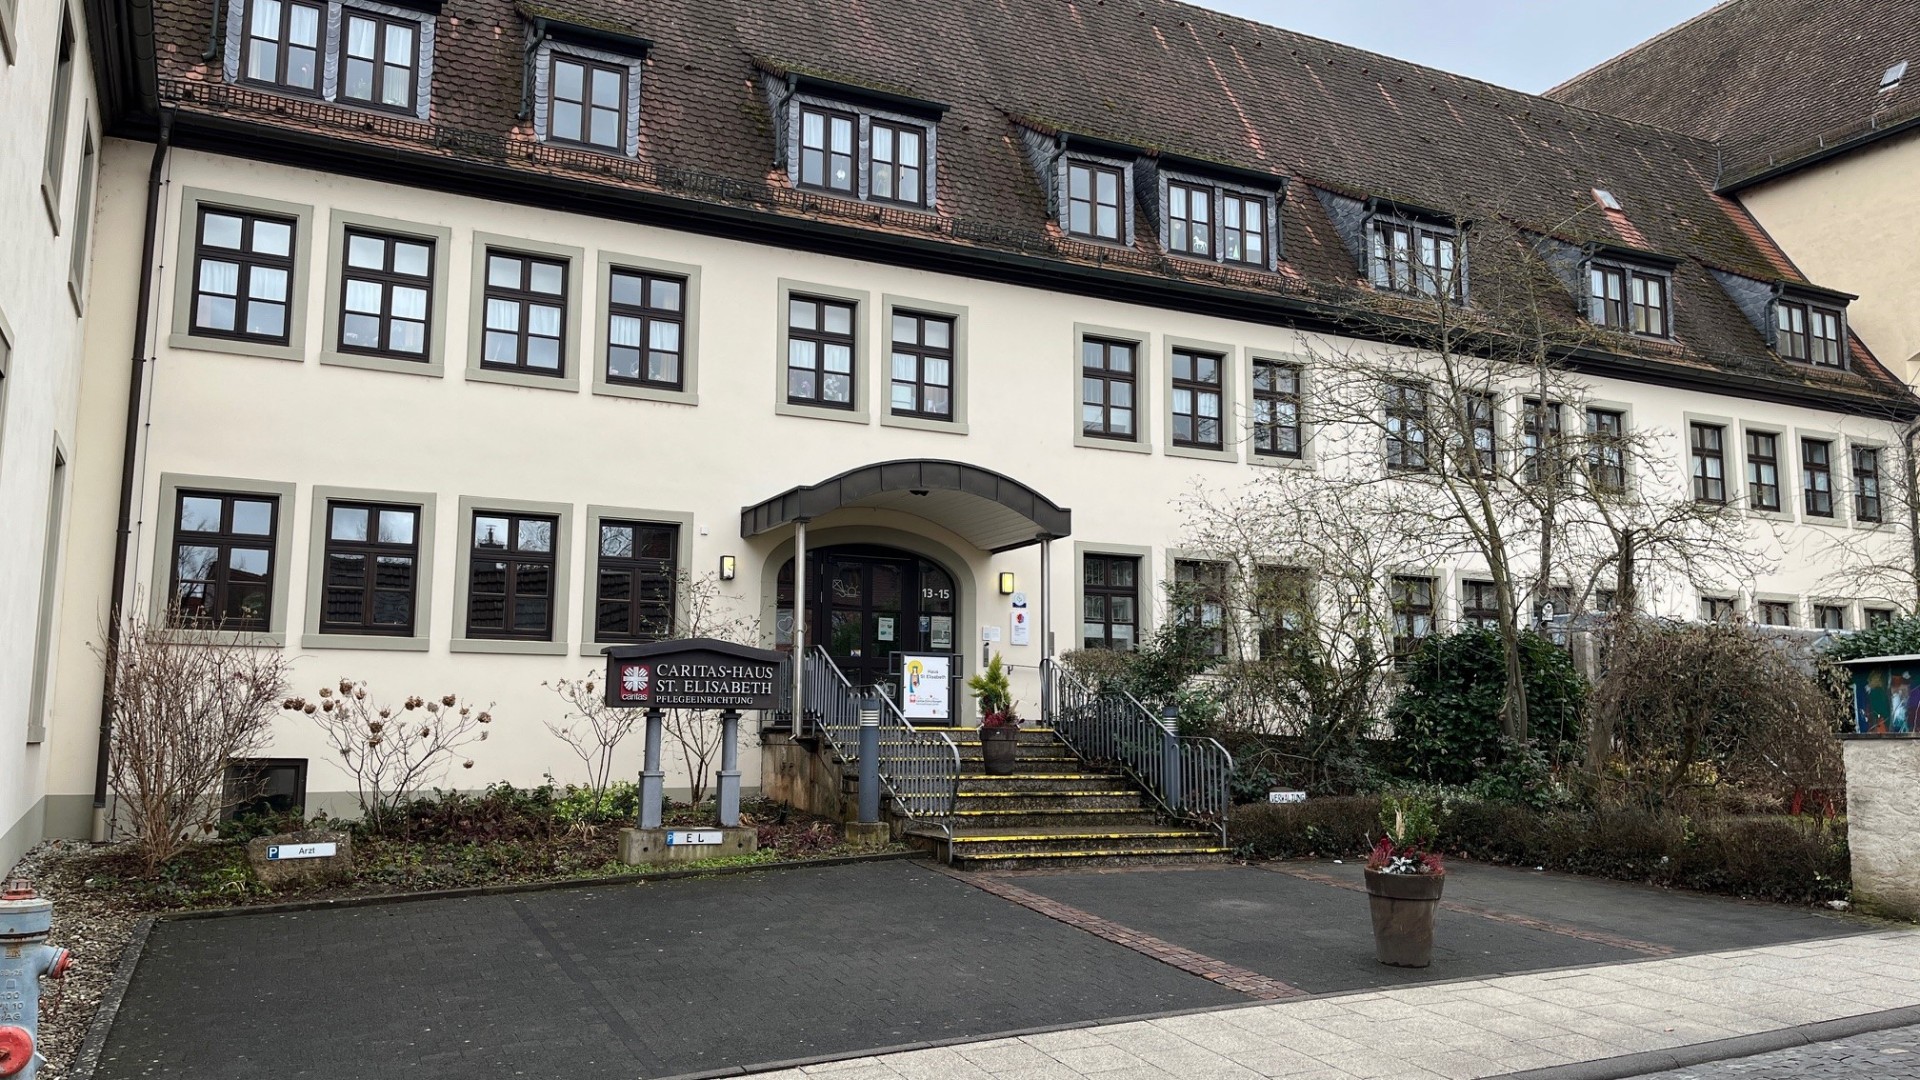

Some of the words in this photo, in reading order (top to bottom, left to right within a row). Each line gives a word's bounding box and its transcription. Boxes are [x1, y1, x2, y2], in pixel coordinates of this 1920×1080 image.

[922, 588, 950, 599] 13-15
[656, 663, 774, 680] CARITAS-HAUS
[655, 680, 678, 693] ST.
[684, 680, 773, 695] ELISABETH
[621, 693, 648, 701] caritas
[656, 695, 754, 705] PFLEGEEINRICHTUNG
[269, 848, 277, 857] P
